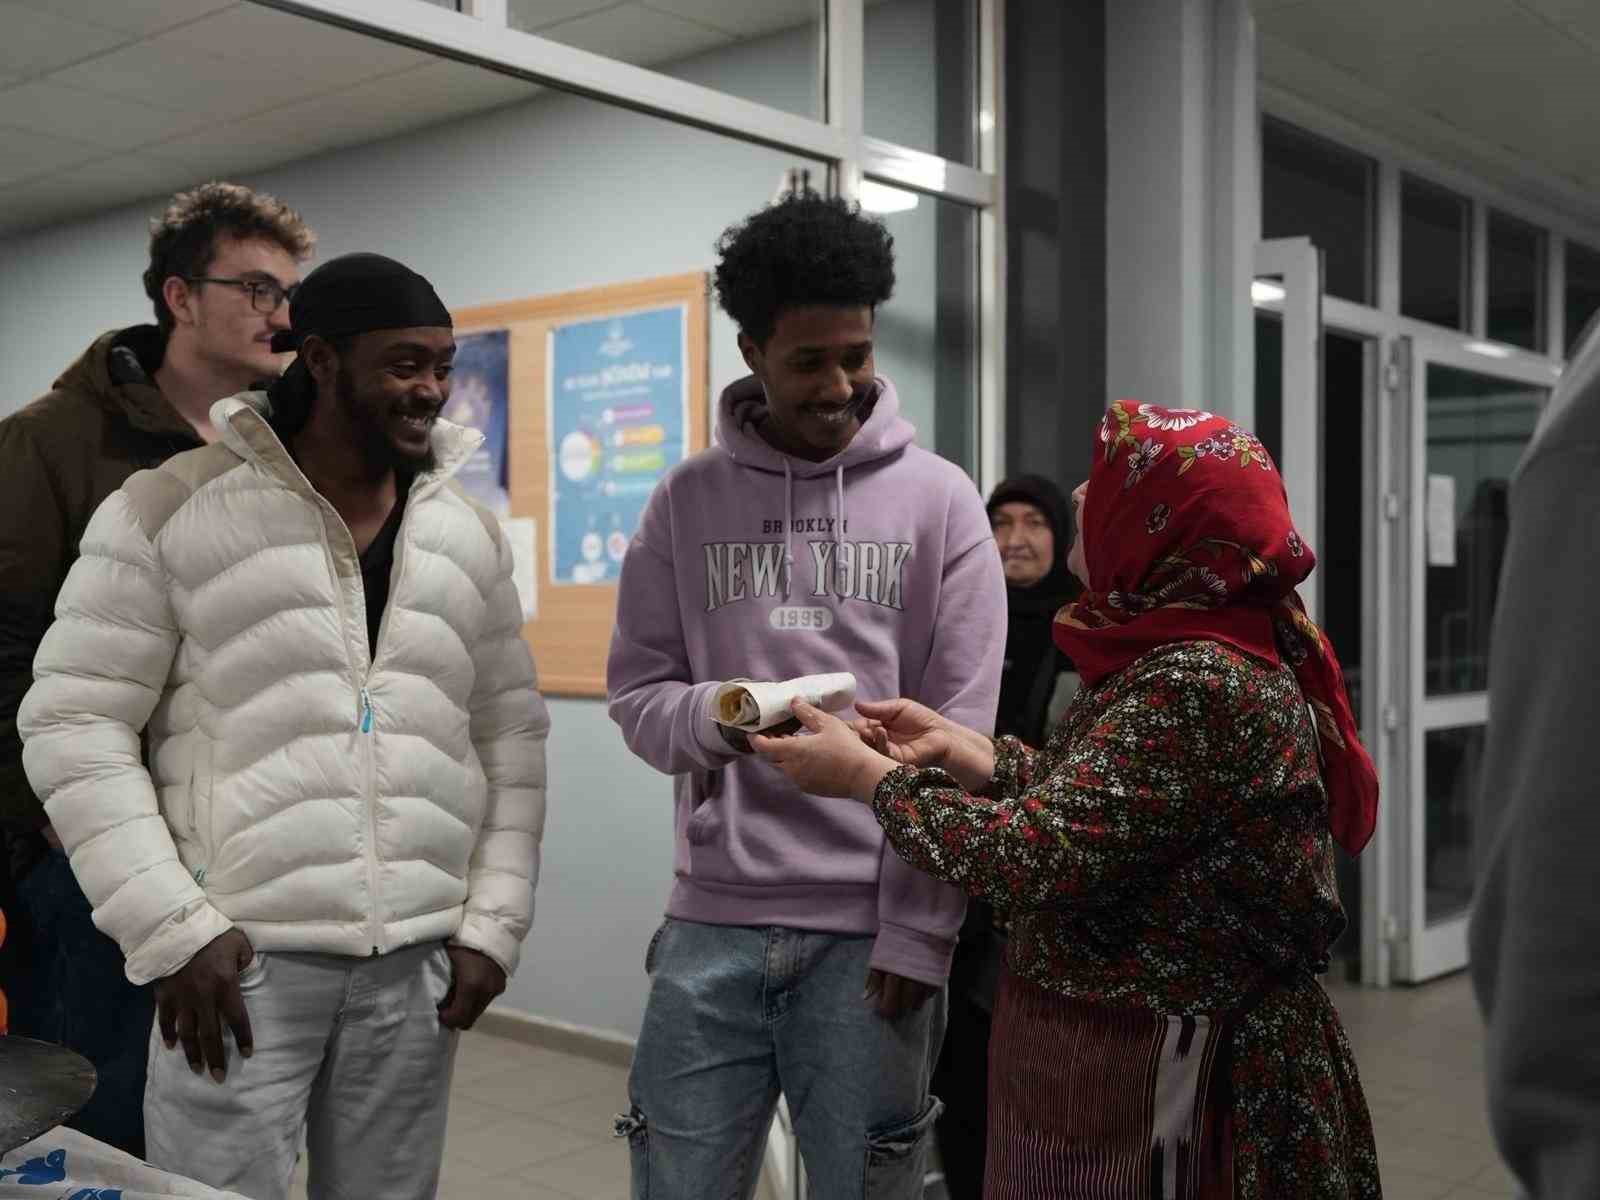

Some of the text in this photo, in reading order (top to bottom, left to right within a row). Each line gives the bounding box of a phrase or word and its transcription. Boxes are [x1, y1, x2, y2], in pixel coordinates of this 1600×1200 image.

[702, 540, 912, 612] NEW YORK
[780, 609, 823, 627] 1995
